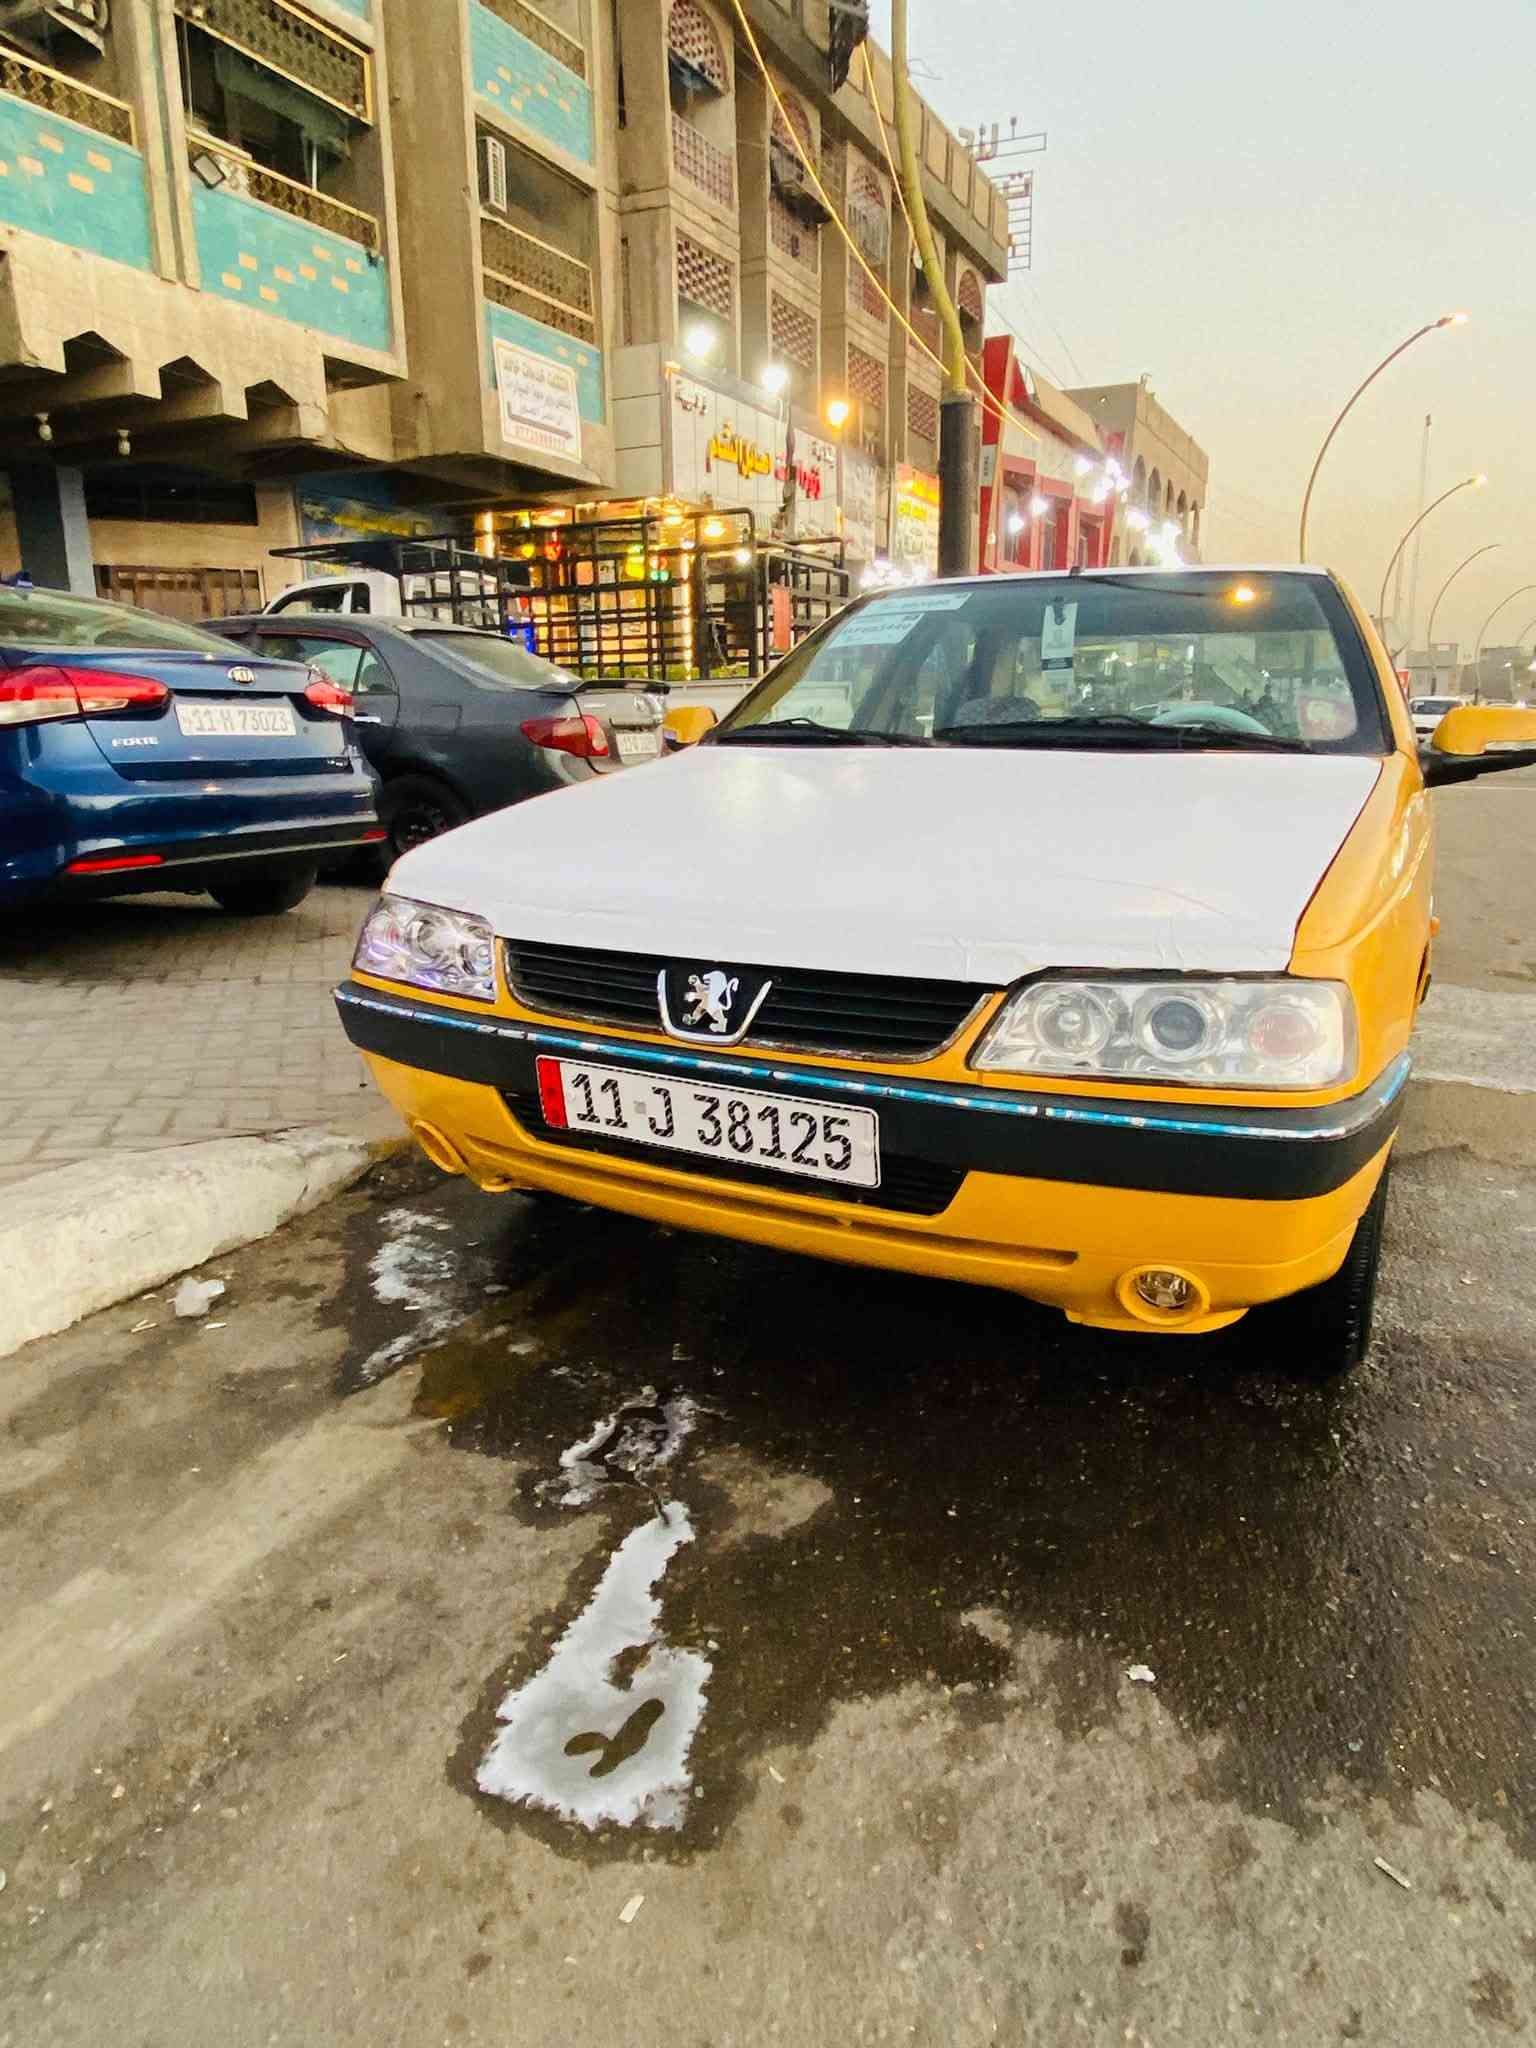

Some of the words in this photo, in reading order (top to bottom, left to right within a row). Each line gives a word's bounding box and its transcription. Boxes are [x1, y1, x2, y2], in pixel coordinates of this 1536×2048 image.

[192, 708, 217, 732] 11
[112, 736, 159, 747] FORTE
[571, 1072, 628, 1129] 11
[647, 1086, 675, 1138] J
[693, 1092, 853, 1172] 38125
